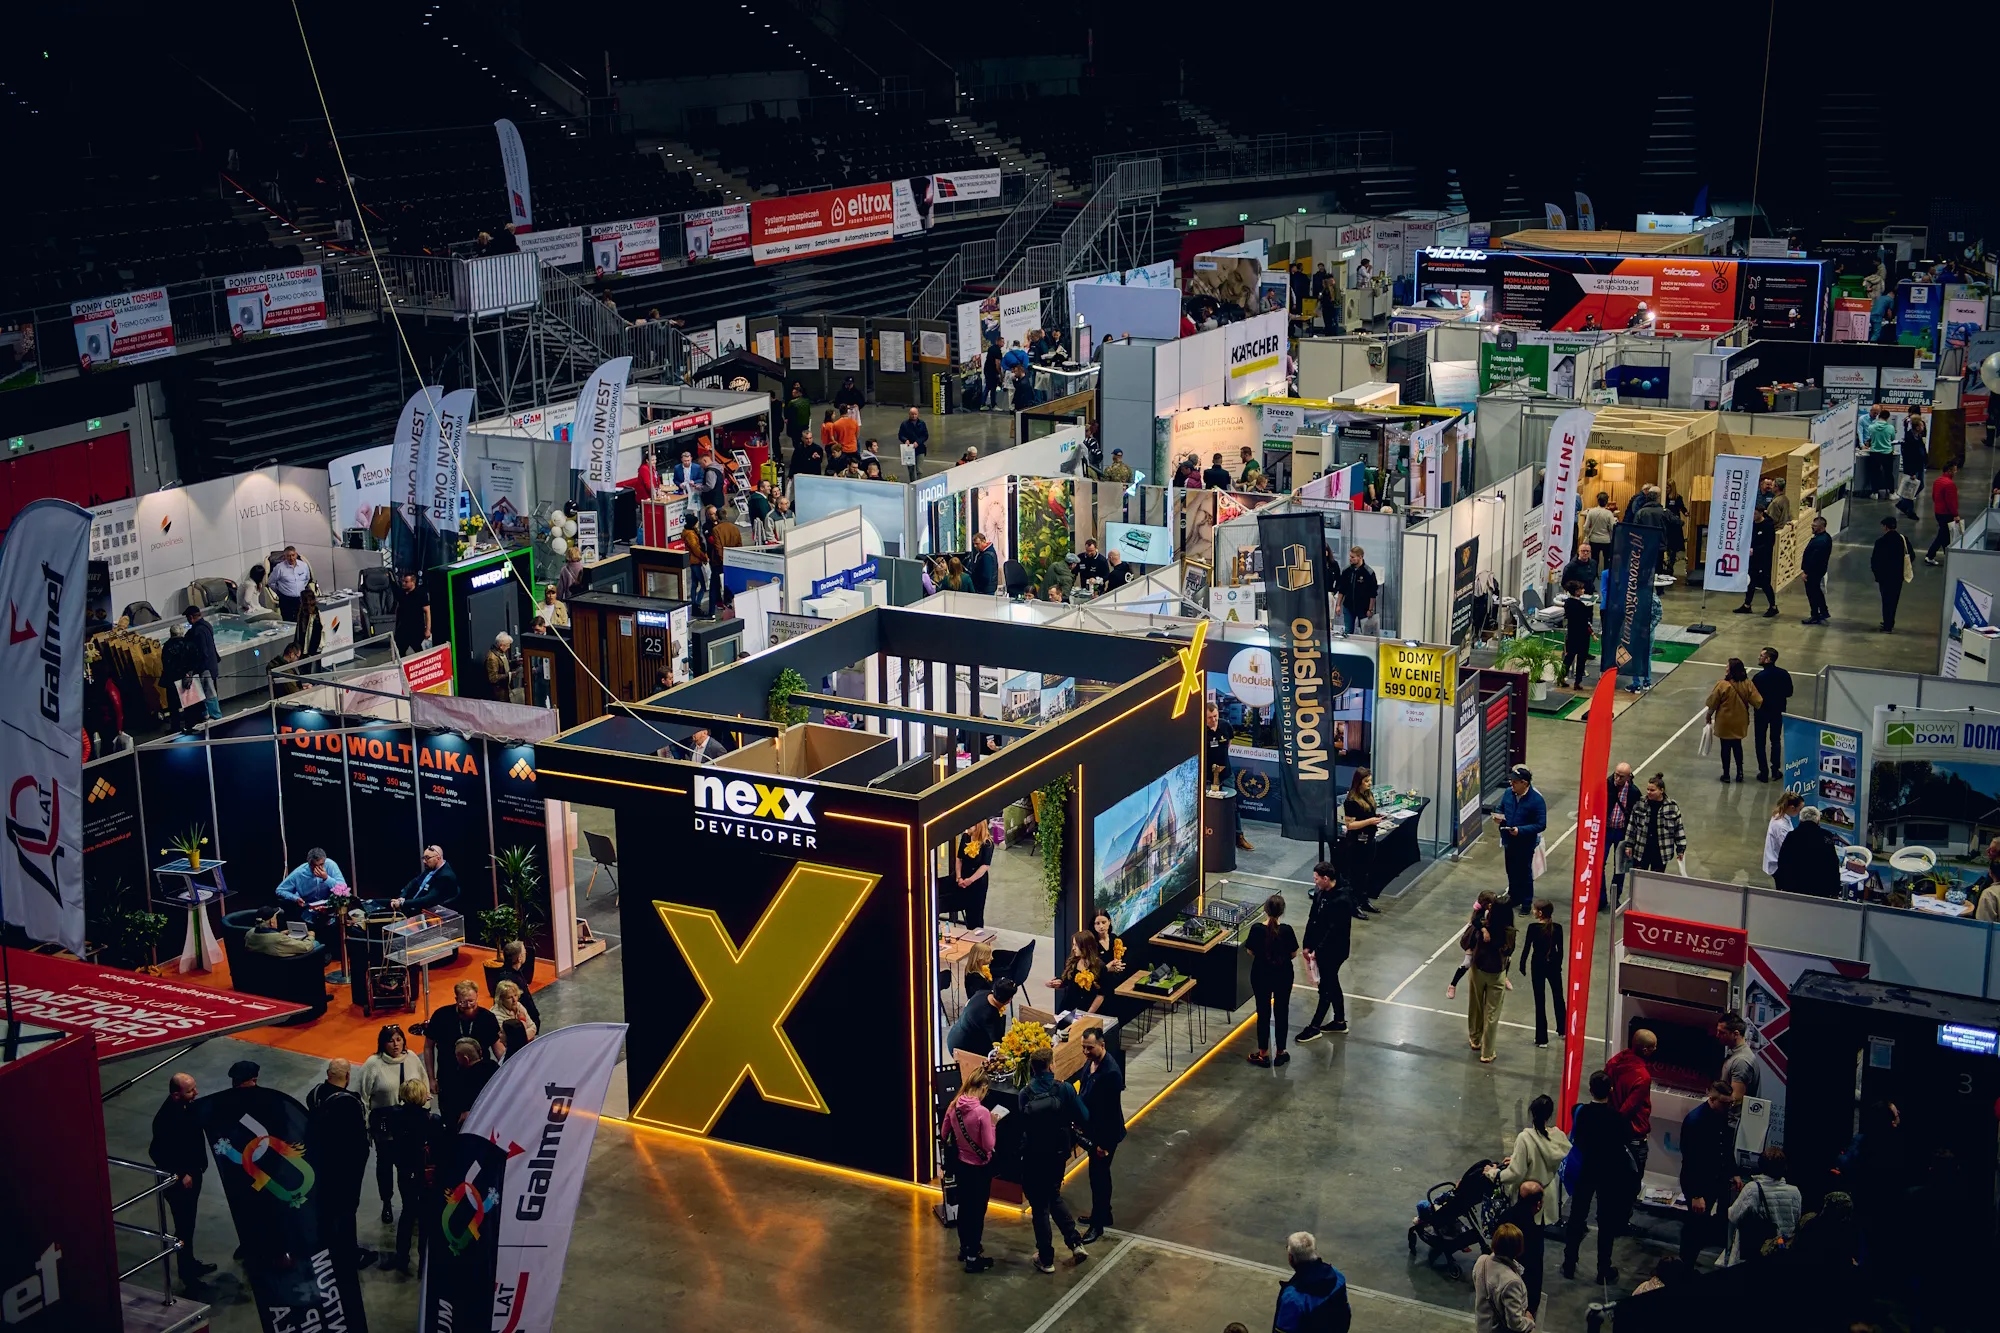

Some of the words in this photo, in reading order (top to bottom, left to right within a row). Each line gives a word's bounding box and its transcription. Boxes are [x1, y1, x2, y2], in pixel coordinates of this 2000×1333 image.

[687, 212, 706, 221] POMPY
[707, 210, 723, 218] CIEPŁA
[724, 205, 744, 216] TOSHIBA
[848, 193, 892, 216] eltrox
[594, 226, 614, 235] POMPY
[614, 223, 633, 232] CIEPŁA
[633, 219, 657, 229] TOSHIBA
[765, 214, 786, 226] Systemy
[787, 209, 820, 222] zabezpieczeń
[766, 245, 790, 255] Monitoring
[795, 242, 811, 251] Alarmy
[815, 239, 828, 247] Smart
[844, 232, 869, 242] Automatyka
[870, 229, 889, 237] bramowa
[1425, 245, 1488, 261] biotop
[229, 276, 257, 287] POMPY
[258, 272, 285, 284] CIEPŁA
[285, 267, 317, 280] TOSHIBA
[1503, 277, 1537, 285] POMALUJ
[1662, 267, 1701, 277] biotop
[76, 302, 103, 314] POMPY
[105, 297, 131, 309] CIEPŁA
[131, 291, 164, 305] TOSHIBA
[272, 294, 292, 302] THERMO
[292, 290, 317, 299] CONTROLS
[1231, 334, 1279, 364] KÄRCHER
[1888, 390, 1924, 398] GRUNTOWE
[1907, 398, 1931, 406] CIEPŁA
[594, 379, 612, 433] INVEST
[610, 381, 621, 428] BUDOWANIA
[1267, 407, 1294, 417] Breeze
[513, 412, 541, 428] HEGAM
[1197, 416, 1244, 427] REKUPERACJA
[437, 409, 454, 468] INVEST
[649, 424, 672, 437] HEGAM
[606, 430, 616, 460] JAKOŚĆ
[589, 434, 605, 482] REMO
[363, 469, 383, 482] REMO
[450, 464, 458, 496] JAKOŚĆ
[604, 461, 612, 483] NOWA
[1551, 432, 1576, 536] SETTLINE
[1723, 468, 1732, 500] Brukowej
[433, 472, 448, 520] REMO
[239, 499, 291, 521] WELLNESS
[292, 502, 301, 512] &
[302, 502, 323, 516] SPA
[448, 497, 456, 521] NOWA
[1720, 501, 1728, 521] Kostki
[1724, 469, 1743, 551] PROFI-BUD
[1717, 523, 1725, 550] Centrum
[1621, 531, 1645, 645] tarasygresowe.pl
[39, 559, 65, 724] Galmet
[644, 637, 662, 653] 25
[1398, 650, 1434, 666] DOMY
[1389, 666, 1403, 679] W
[1405, 668, 1441, 683] CENIE
[1385, 682, 1407, 696] 599
[1409, 684, 1432, 699] 000
[1435, 686, 1450, 701] ZŁ
[1916, 723, 1956, 732] NOWY
[1835, 741, 1856, 750] DOM
[1836, 735, 1856, 743] NOWY
[1915, 733, 1955, 744] DOM
[304, 764, 317, 774] 500
[317, 767, 329, 776] kWp
[1785, 756, 1809, 771] Budujemy
[1793, 768, 1801, 777] od
[353, 771, 367, 781] 735
[366, 775, 379, 784] kWp
[386, 777, 399, 786] 350
[399, 780, 411, 789] kWp
[1803, 779, 1816, 792] lat
[432, 784, 446, 795] 250
[445, 788, 458, 798] kWp
[694, 774, 817, 827] nexx
[38, 783, 53, 827] LAT
[694, 817, 818, 850] DEVELOPER
[1632, 921, 1729, 951] ROTENSO
[1704, 947, 1725, 957] better
[98, 973, 140, 986] Polsce
[67, 983, 140, 1002] CIEPŁA
[158, 982, 245, 1004] Produkujemy
[146, 998, 209, 1018] POMPY
[1958, 1073, 1973, 1094] 3
[515, 1080, 577, 1222] Galmet
[493, 1282, 515, 1318] LAT
